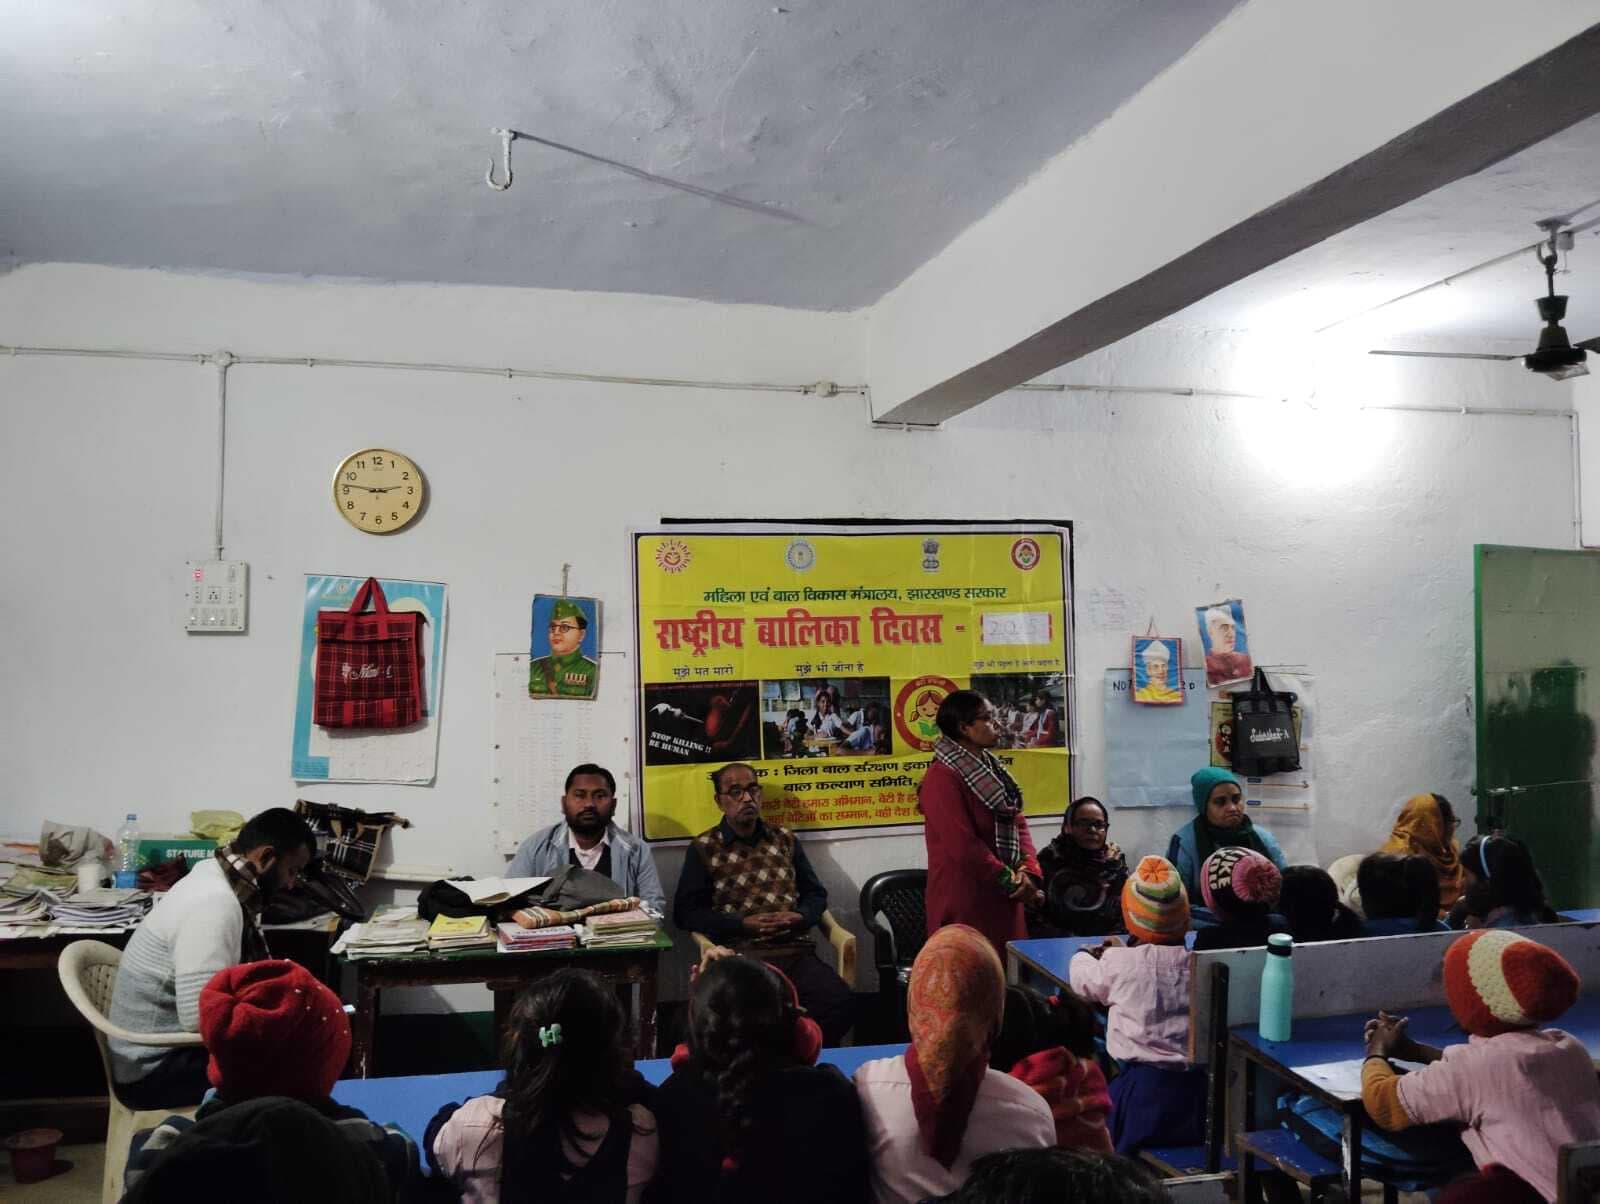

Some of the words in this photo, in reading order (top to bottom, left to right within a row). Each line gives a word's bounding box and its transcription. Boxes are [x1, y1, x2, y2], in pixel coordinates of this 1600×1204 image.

[356, 461, 365, 469] 11
[372, 457, 383, 465] 12
[391, 461, 395, 469] 1
[346, 472, 357, 481] 10
[402, 472, 409, 480] 2
[343, 486, 350, 495] 9
[407, 487, 414, 495] 3
[347, 501, 354, 510] 8
[402, 501, 409, 509] 4
[360, 512, 366, 520] 7
[375, 516, 382, 525] 6
[391, 512, 398, 520] 5
[703, 587, 746, 603] महिला
[750, 586, 770, 602] एवं
[773, 590, 801, 602] बाल
[803, 586, 847, 601] विकास
[906, 588, 961, 600] झारखण्ड
[964, 587, 1008, 599] सरकार
[653, 609, 745, 657] राष्ट्रीय
[754, 607, 861, 648] बालिका
[870, 606, 943, 646] दिवस
[795, 660, 811, 677] मुझे
[816, 660, 828, 672] भी
[651, 731, 671, 742] STOP
[672, 737, 704, 752] KILLING
[649, 739, 660, 748] BE
[661, 742, 689, 756] HUMAN
[784, 764, 818, 777] जिला
[822, 764, 850, 775] बाल
[903, 759, 931, 771] इका
[784, 782, 812, 793] बाल
[816, 779, 864, 791] कल्याण
